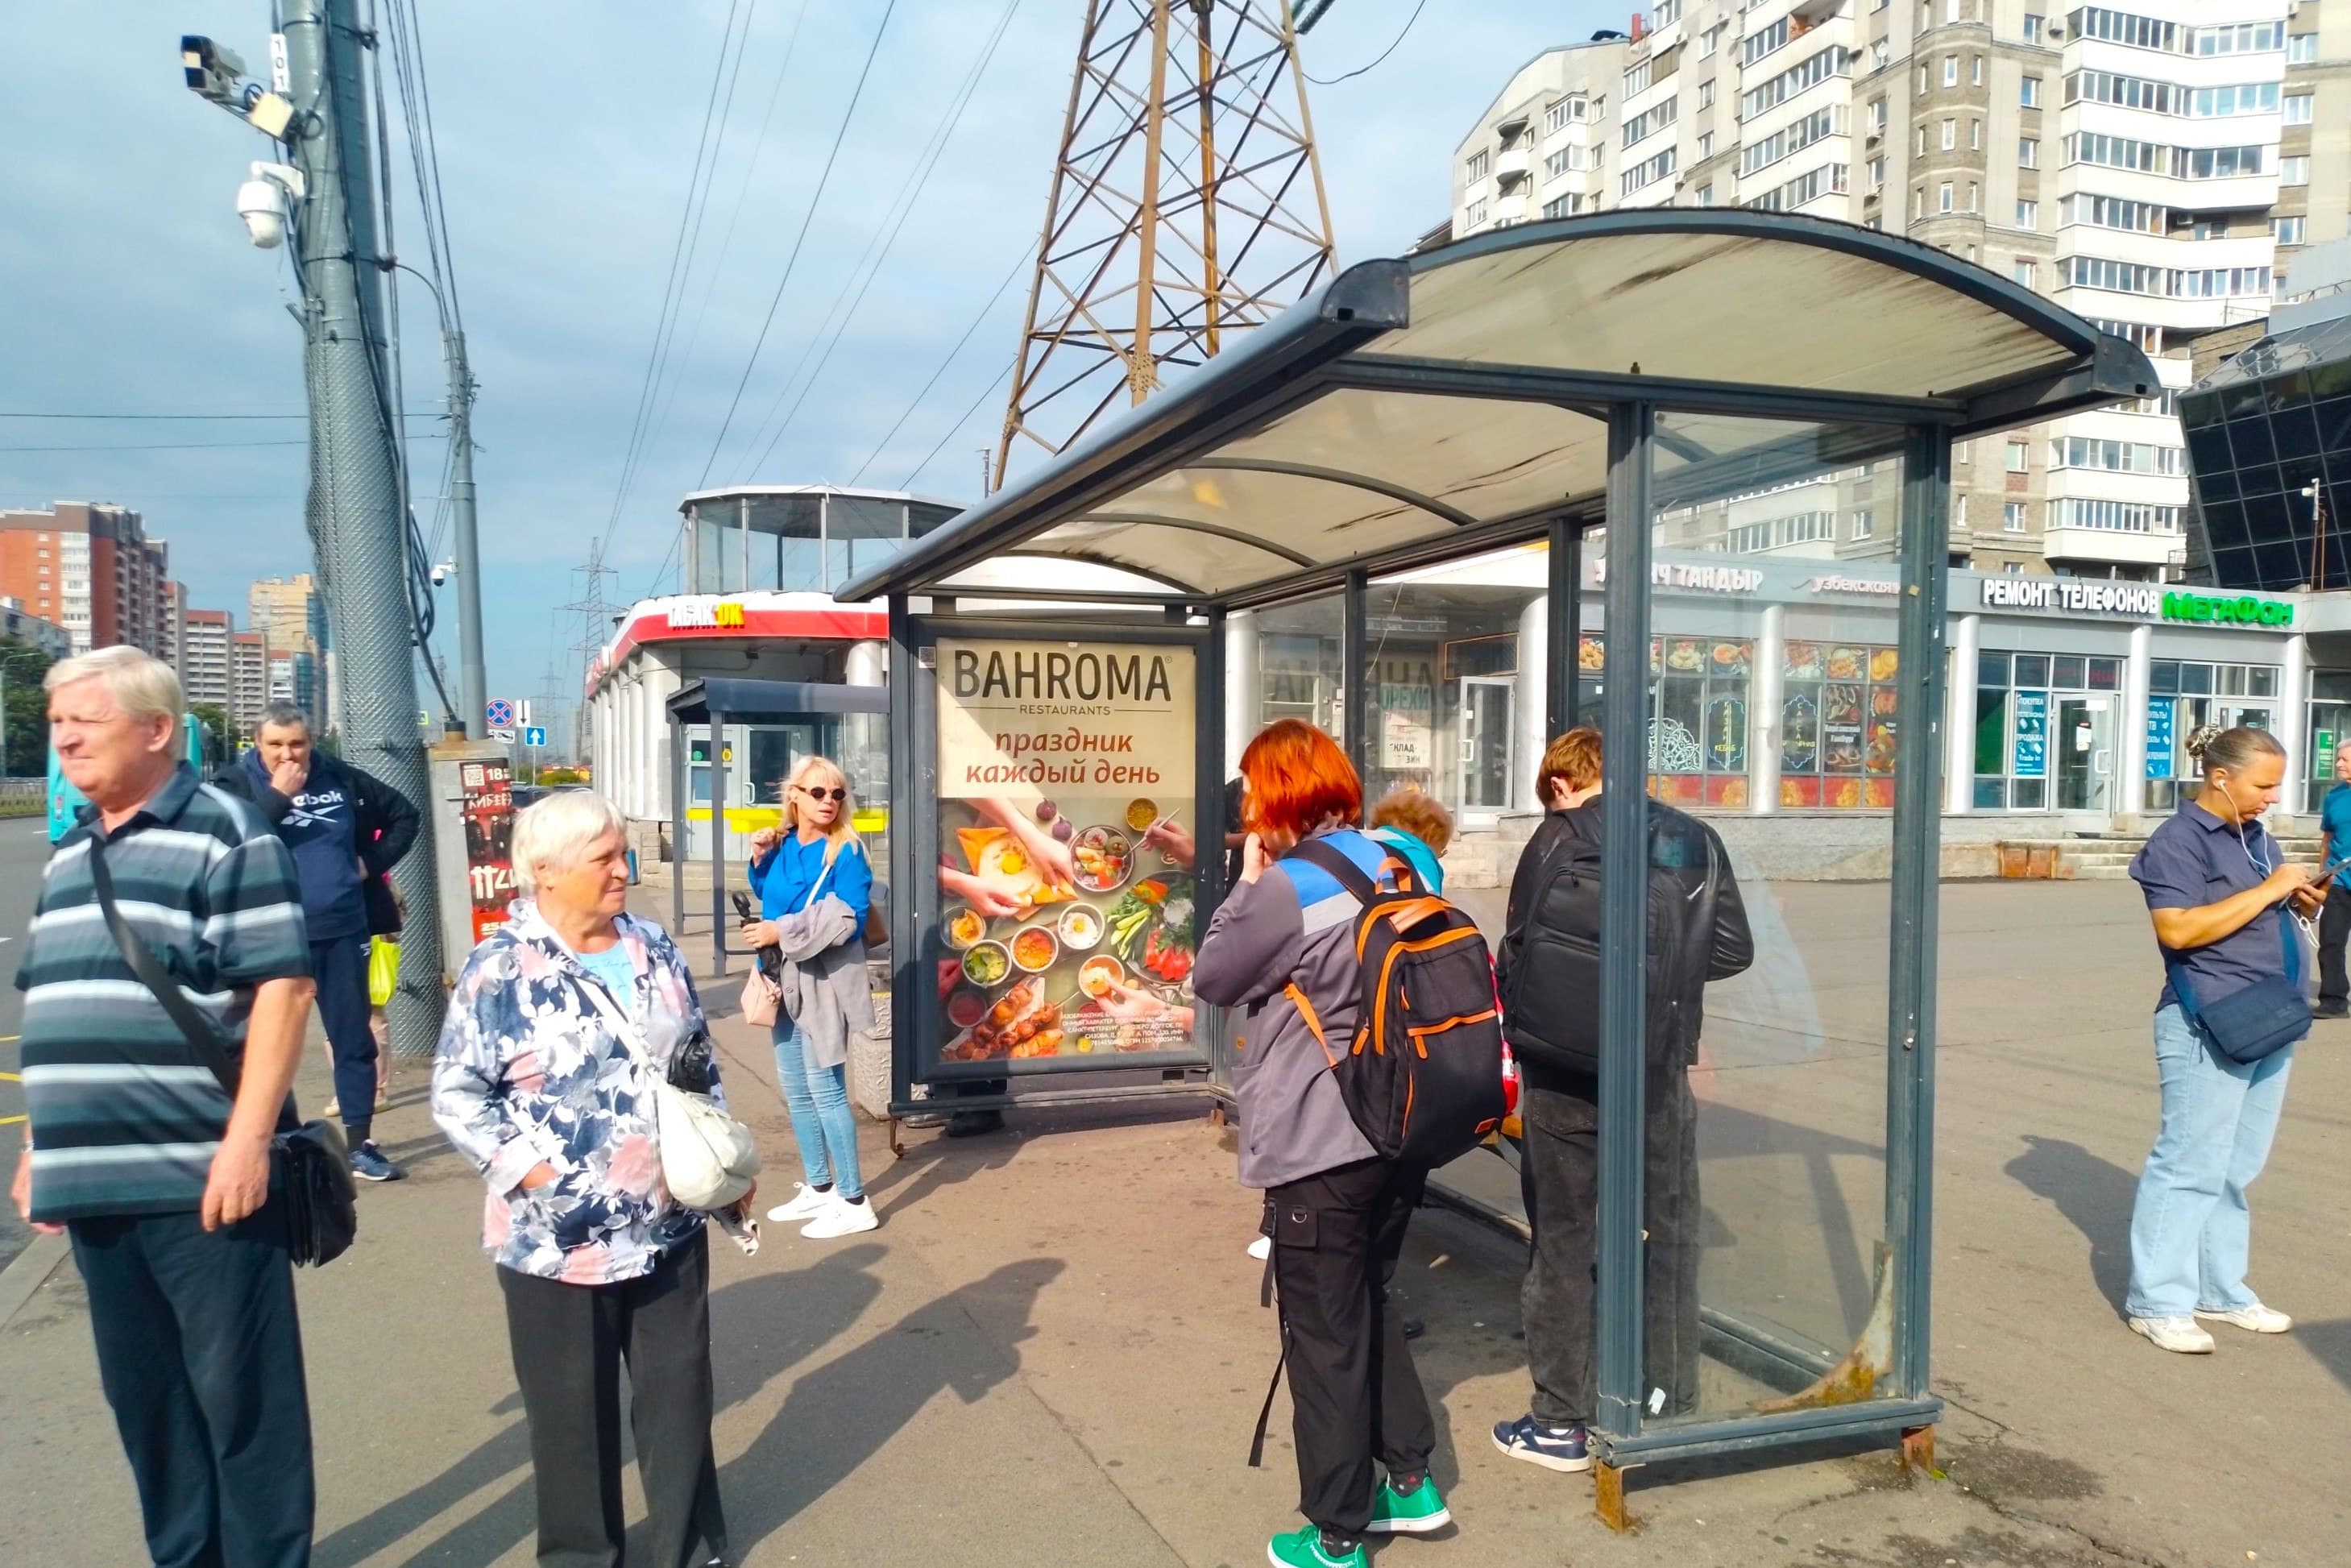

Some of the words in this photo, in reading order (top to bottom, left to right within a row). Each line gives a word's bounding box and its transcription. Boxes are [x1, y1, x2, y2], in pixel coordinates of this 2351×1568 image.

[1675, 564, 1764, 593] ТАНДЫР
[1983, 579, 2054, 607] РЕМОНТ
[2059, 583, 2160, 614] ТЕЛЕФОНОВ
[954, 649, 1171, 702] BAHROMA
[1019, 704, 1111, 716] RESTAURANTS
[995, 727, 1134, 758] праздник
[486, 767, 504, 781] 18
[967, 758, 1086, 784] каждый
[1094, 758, 1160, 784] день
